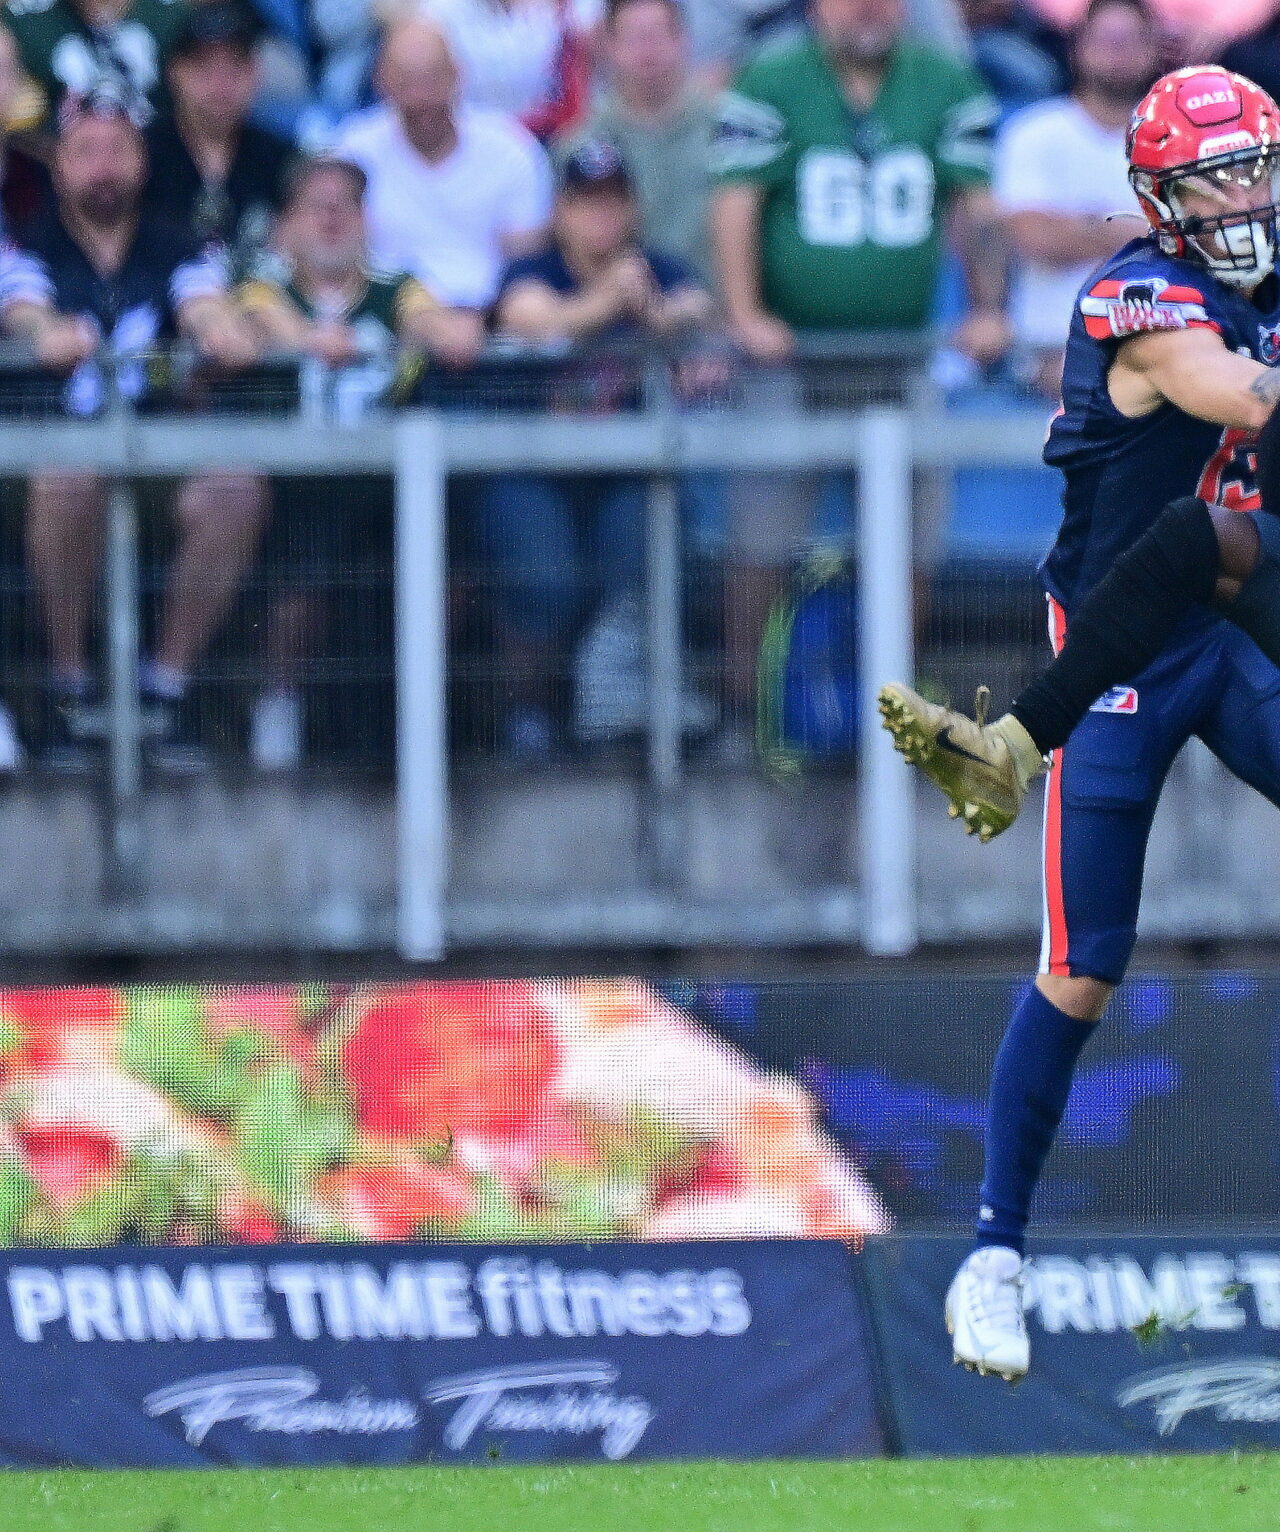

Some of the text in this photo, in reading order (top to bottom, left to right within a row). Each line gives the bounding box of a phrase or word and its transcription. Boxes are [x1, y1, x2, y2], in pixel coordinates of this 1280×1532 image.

[796, 147, 935, 247] 60
[7, 1256, 752, 1342] PRIME TIME fitness
